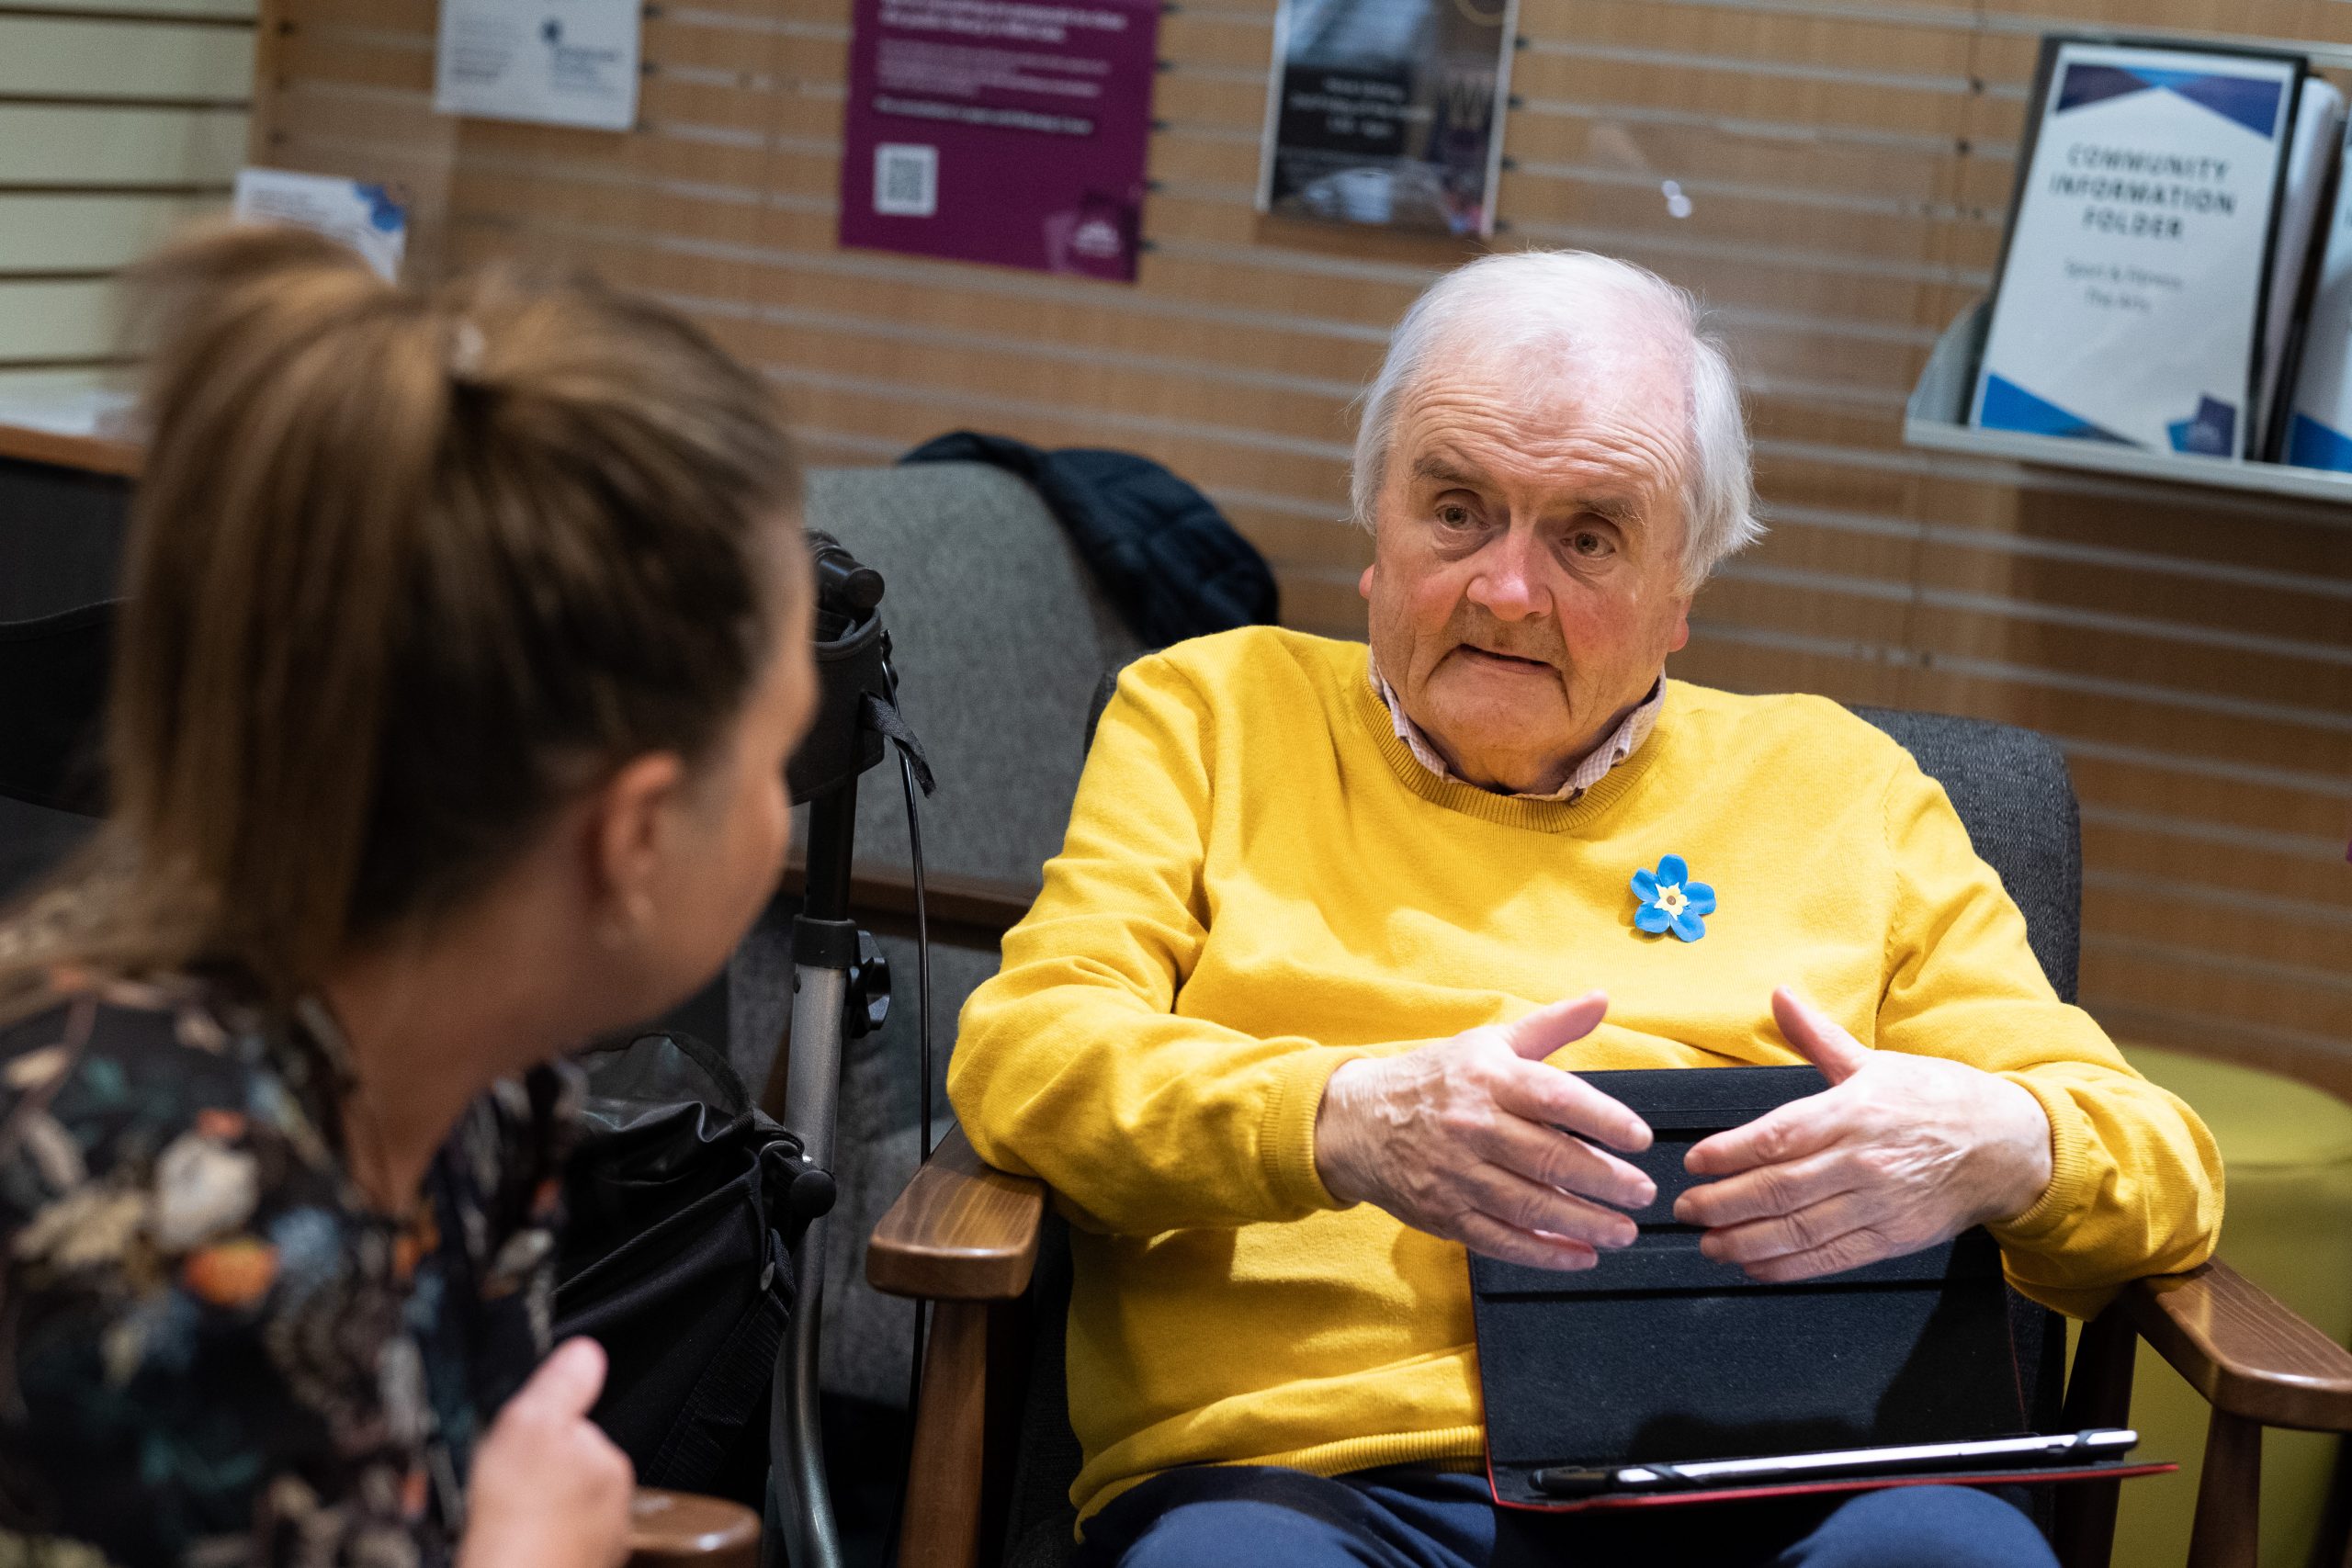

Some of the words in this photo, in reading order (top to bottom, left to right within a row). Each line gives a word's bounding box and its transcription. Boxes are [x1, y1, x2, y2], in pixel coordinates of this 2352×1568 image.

[2067, 142, 2231, 181] COMMUNITY
[2050, 173, 2236, 215] INFORMATION
[2083, 207, 2183, 240] FOLDER
